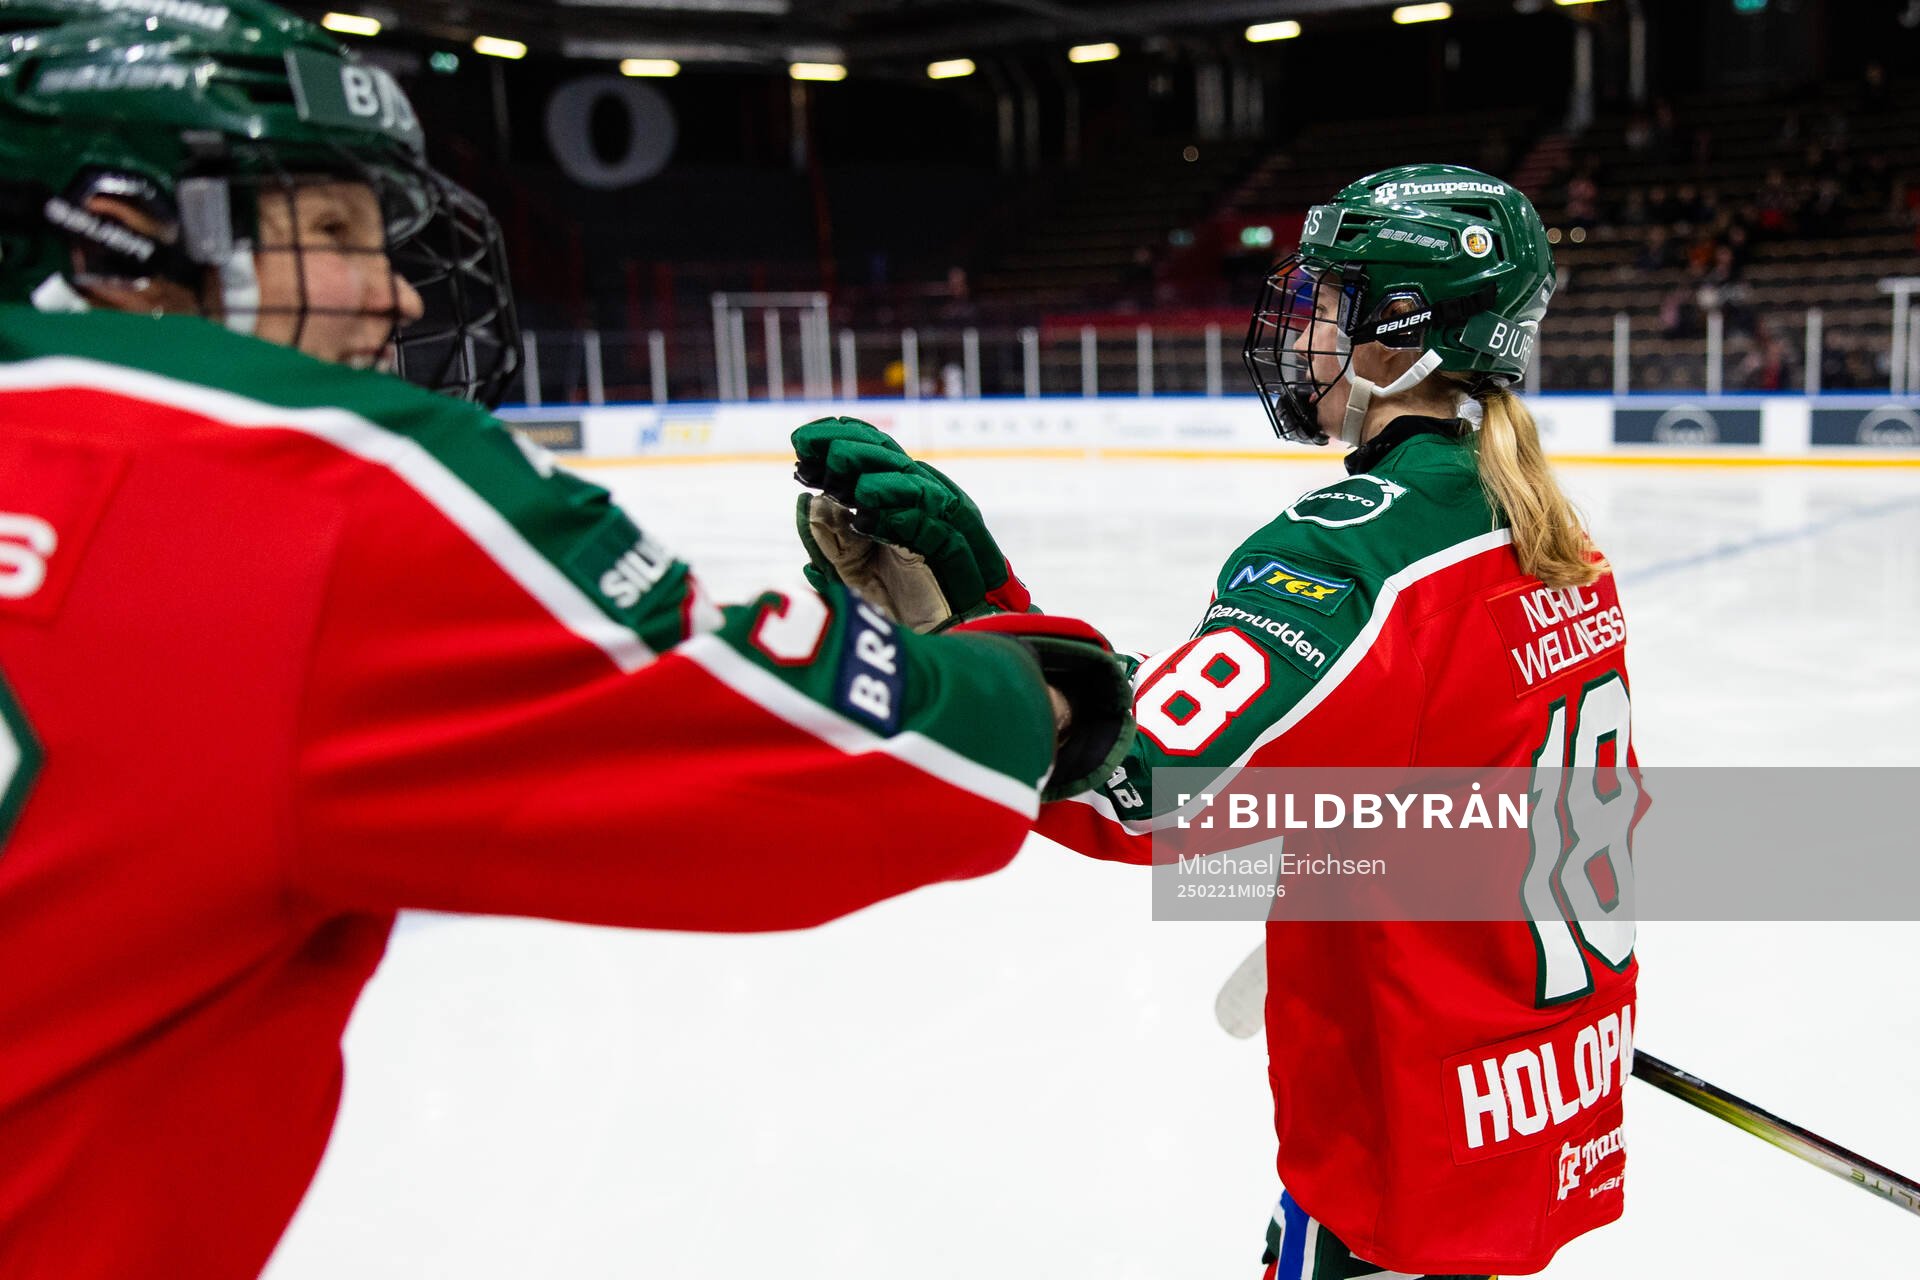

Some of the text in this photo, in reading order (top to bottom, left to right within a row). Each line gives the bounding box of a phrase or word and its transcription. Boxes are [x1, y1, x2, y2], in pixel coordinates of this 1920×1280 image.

[1400, 182, 1505, 196] Tranpenad
[1377, 228, 1449, 250] BAUER
[1376, 311, 1432, 334] BAUER
[1305, 492, 1375, 507] VOLVO
[1207, 603, 1325, 668] Ramudden
[1511, 605, 1625, 685] WELLNESS
[1519, 669, 1638, 1008] 18
[1850, 1167, 1920, 1210] LITE
